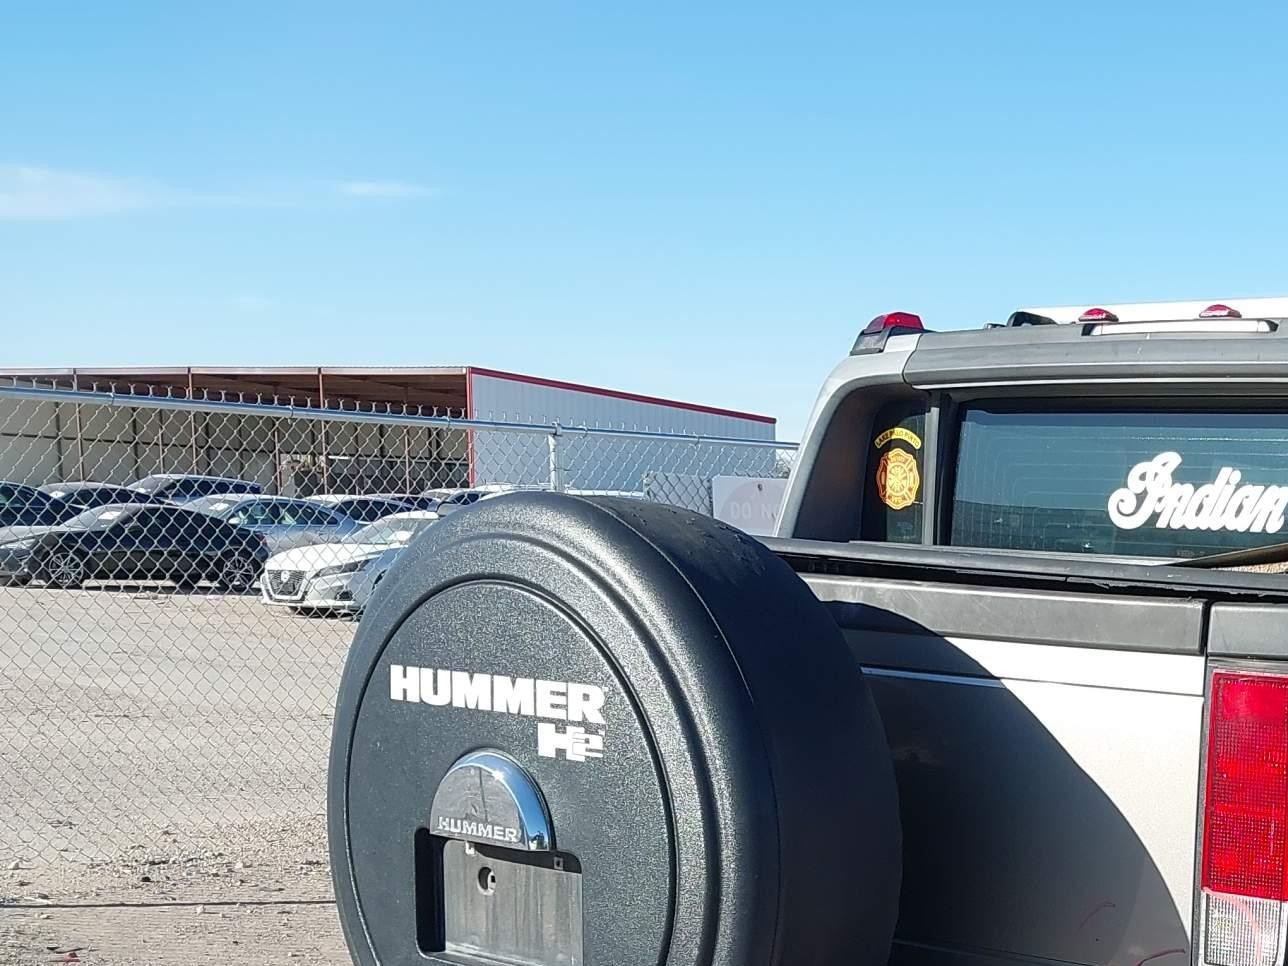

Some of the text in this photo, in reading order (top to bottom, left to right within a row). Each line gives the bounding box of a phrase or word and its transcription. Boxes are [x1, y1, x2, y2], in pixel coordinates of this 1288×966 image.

[730, 501, 752, 519] DO
[390, 664, 607, 724] HUMMER
[537, 722, 604, 762] H2
[438, 816, 520, 843] HUMMER
